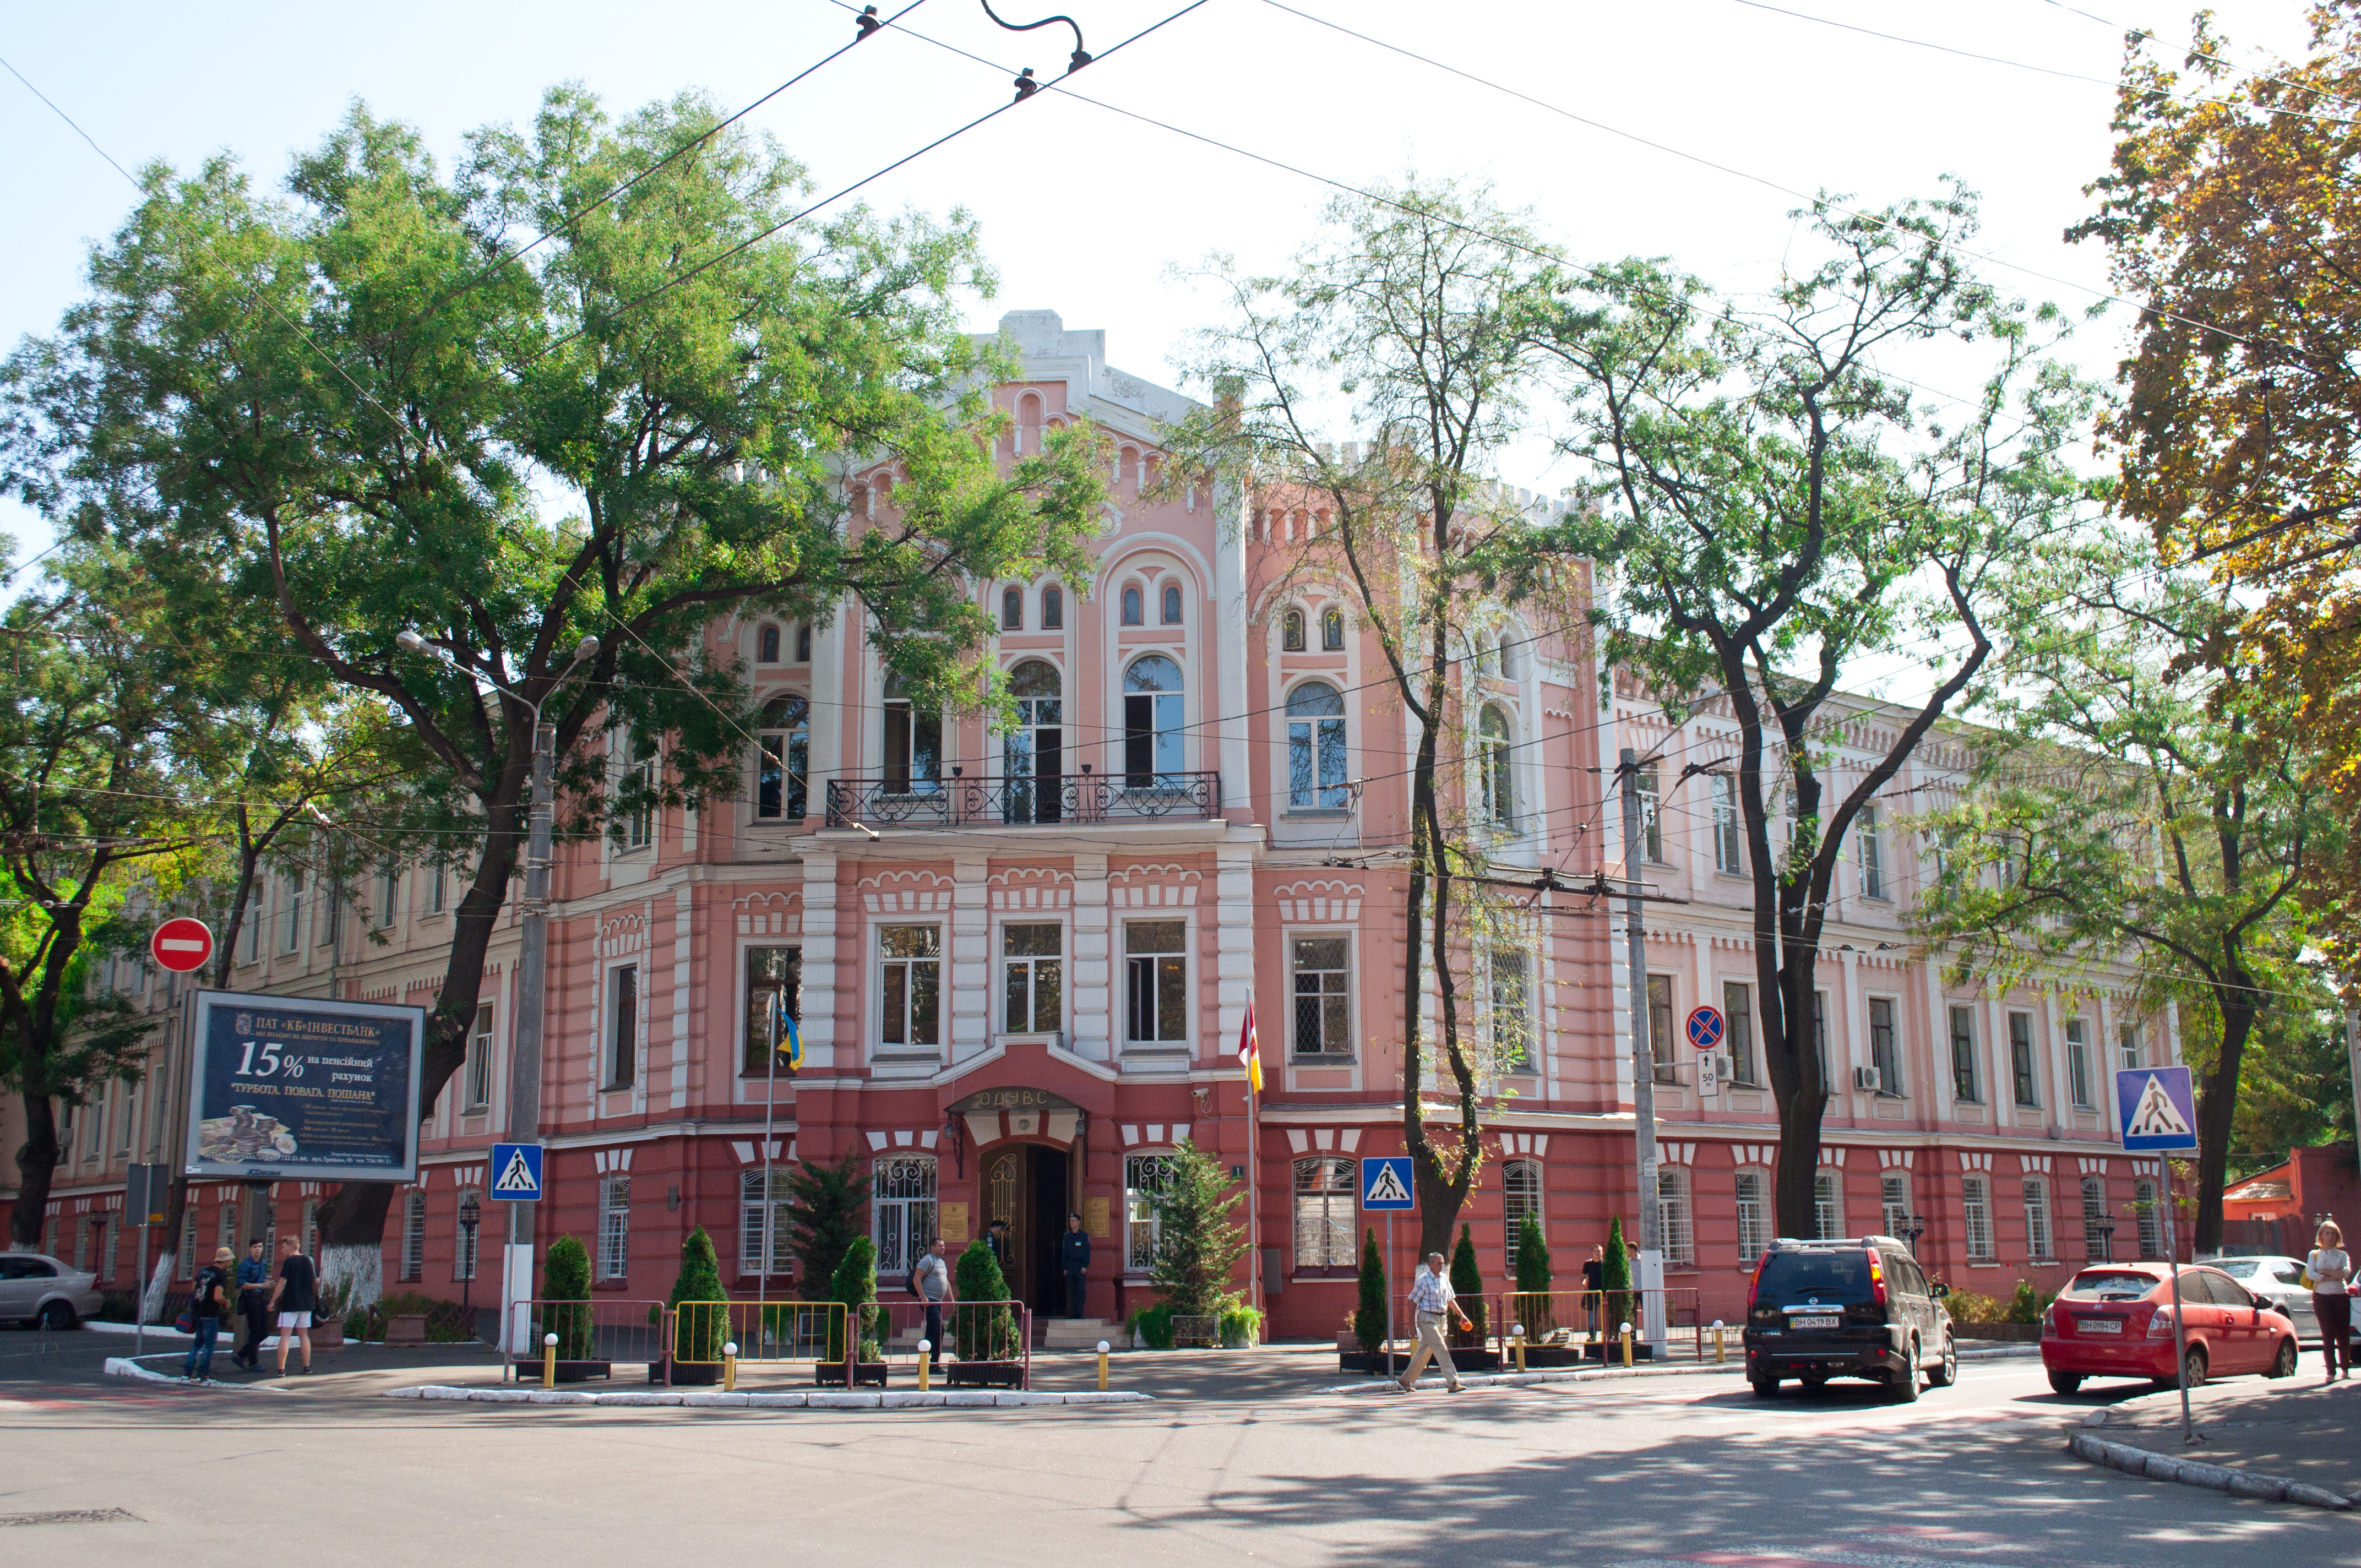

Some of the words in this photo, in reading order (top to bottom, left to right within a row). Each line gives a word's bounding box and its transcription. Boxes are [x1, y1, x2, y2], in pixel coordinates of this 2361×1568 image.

[255, 1017, 278, 1029] ПАТ
[235, 1041, 304, 1078] 15%
[322, 1057, 373, 1068] пенсійний
[331, 1072, 372, 1083] рахунок
[1702, 1072, 1713, 1082] 50
[980, 1091, 1046, 1106] ОДУВС
[1237, 1167, 1239, 1176] 1
